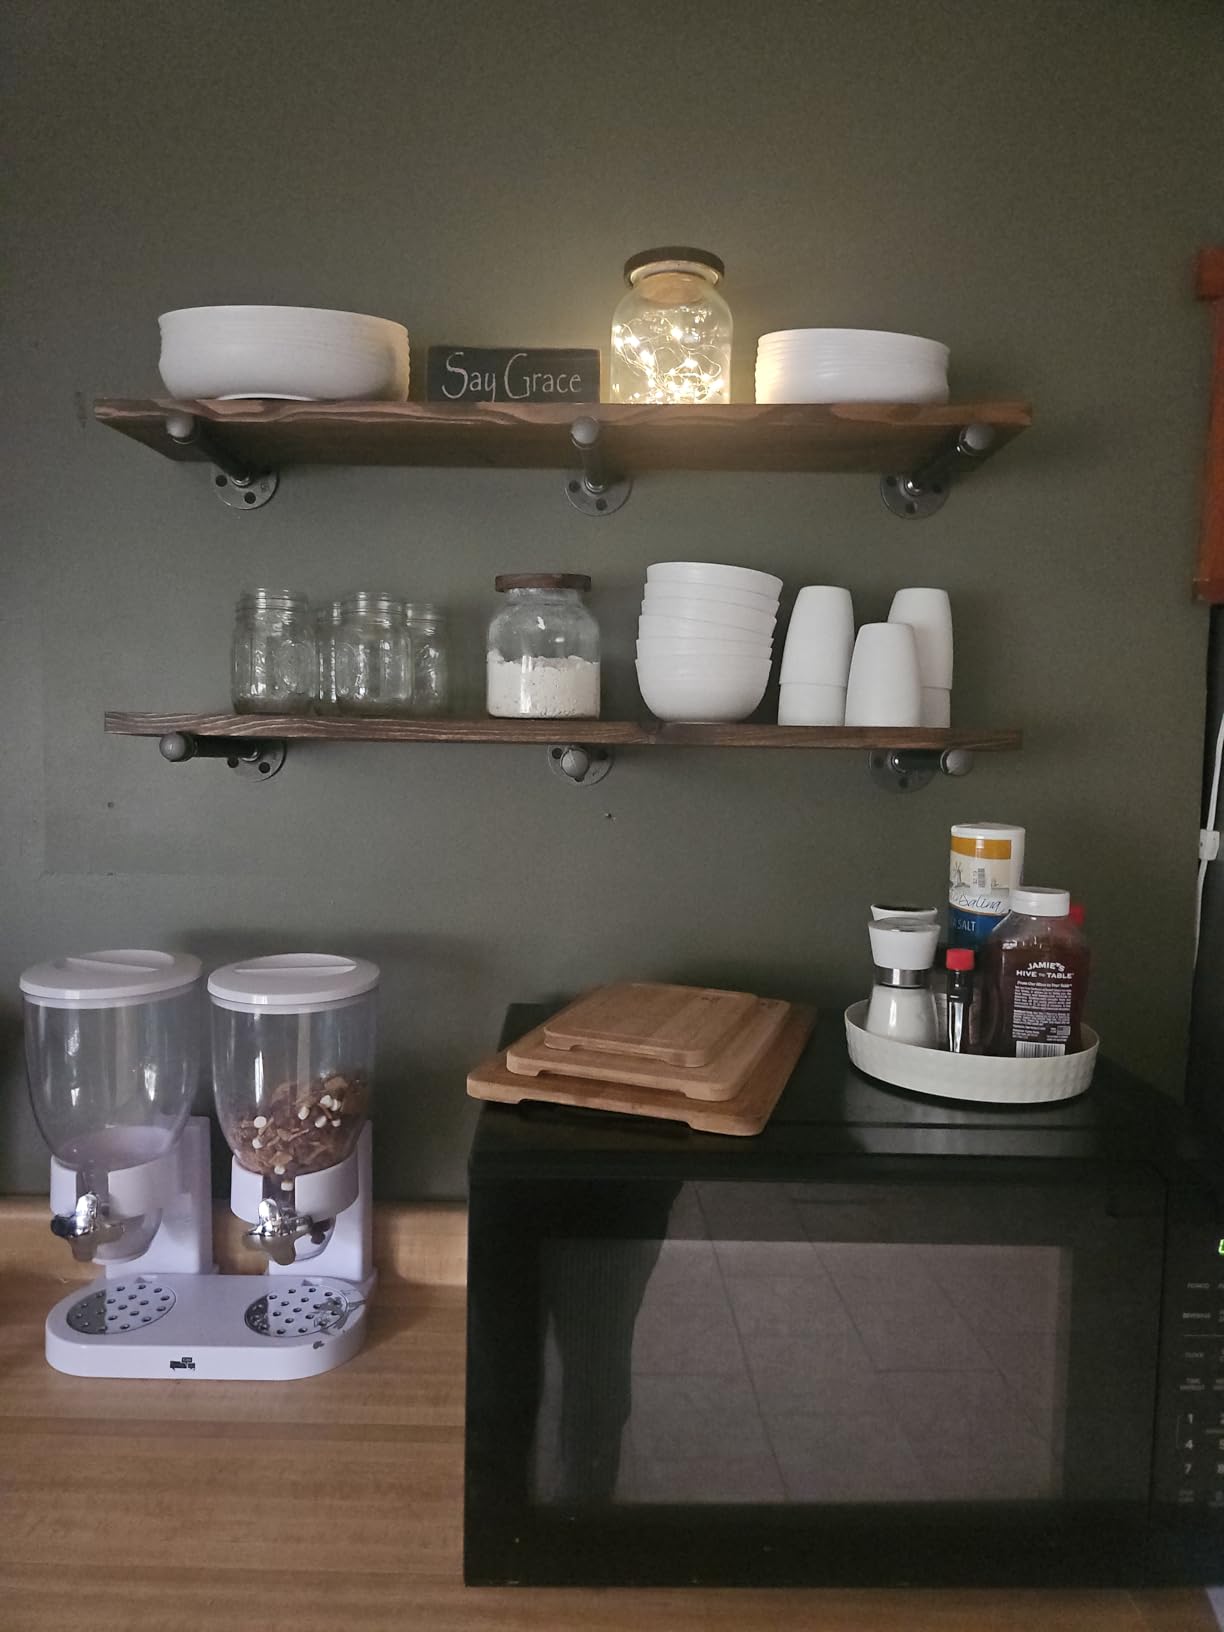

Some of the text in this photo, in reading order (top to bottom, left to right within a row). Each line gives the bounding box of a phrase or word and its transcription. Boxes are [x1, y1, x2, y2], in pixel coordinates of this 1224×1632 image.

[442, 352, 582, 402] Say Grace
[958, 919, 976, 932] SALT
[1016, 970, 1037, 978] HIVE
[1187, 1413, 1193, 1424] 1
[1185, 1440, 1193, 1449] 4
[1184, 1463, 1192, 1474] 7
